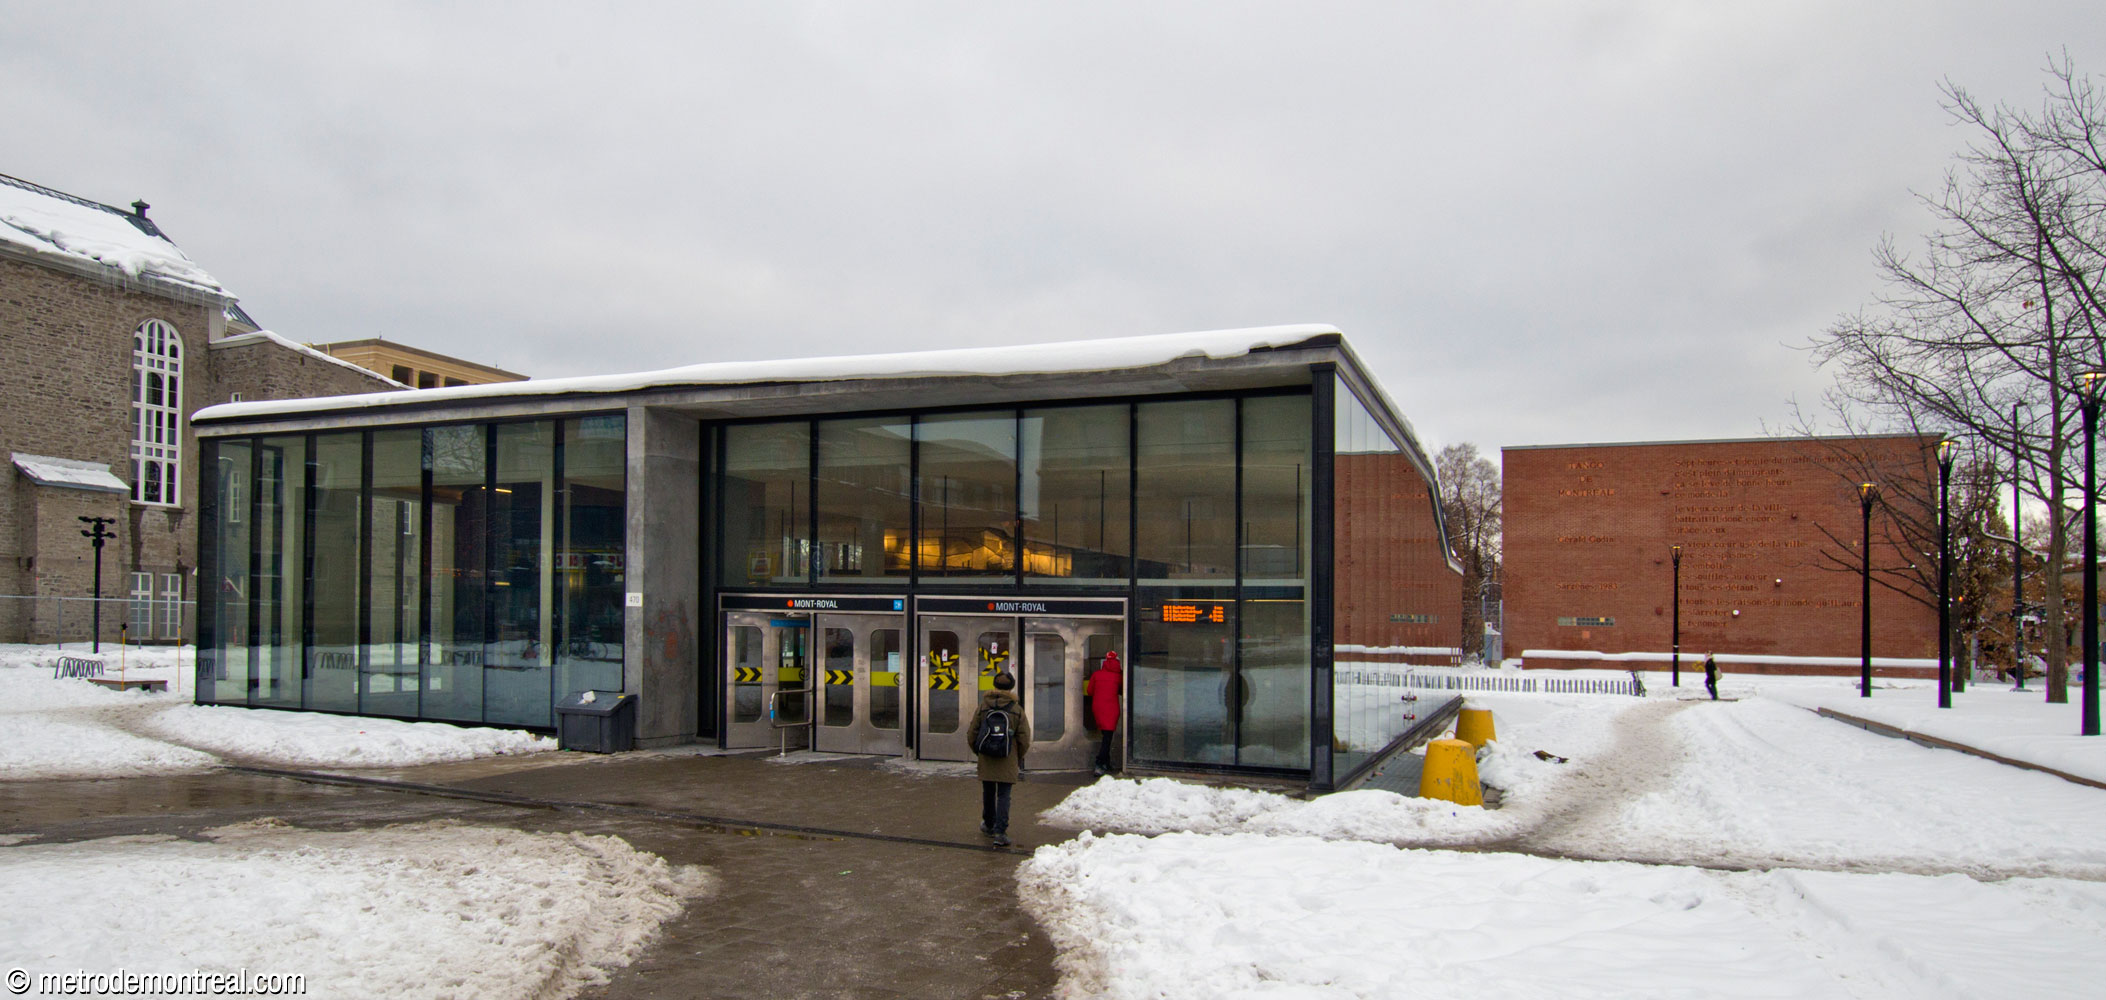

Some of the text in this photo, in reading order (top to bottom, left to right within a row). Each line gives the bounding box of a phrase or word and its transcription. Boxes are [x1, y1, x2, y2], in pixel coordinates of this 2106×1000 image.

[1568, 461, 1604, 470] TANGO
[1700, 469, 1722, 479] plein
[1674, 504, 1685, 512] le
[1764, 504, 1787, 512] ville
[1722, 514, 1743, 522] donc
[1588, 535, 1614, 543] Godin
[794, 600, 838, 609] MONT-ROYAL
[996, 602, 1046, 612] MONT-ROYAL
